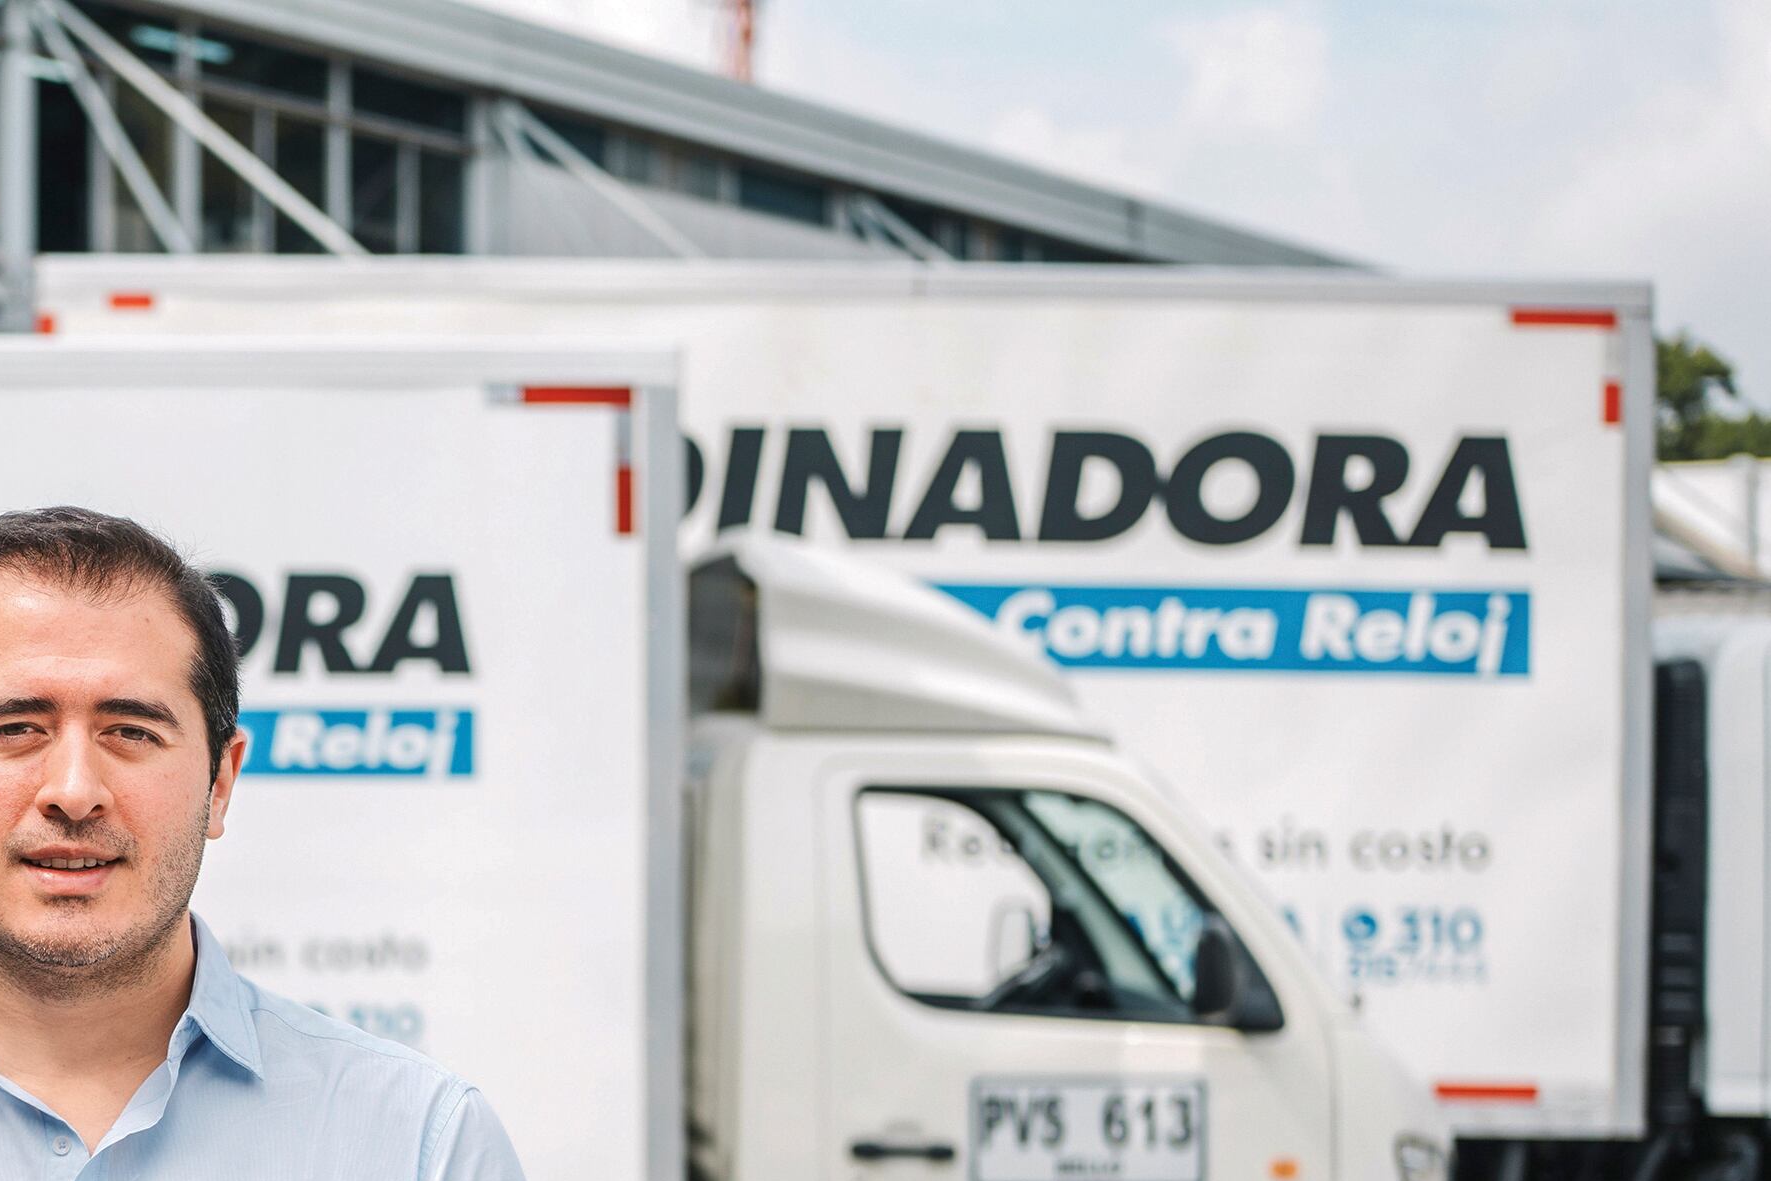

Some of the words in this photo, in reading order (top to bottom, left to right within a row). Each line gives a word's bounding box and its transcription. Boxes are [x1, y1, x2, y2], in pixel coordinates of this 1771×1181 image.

[685, 428, 1529, 550] INADORA
[1300, 590, 1512, 679] Reloj
[270, 710, 458, 780] Reloj
[1258, 818, 1328, 871] sin
[979, 1097, 1064, 1148] PVS
